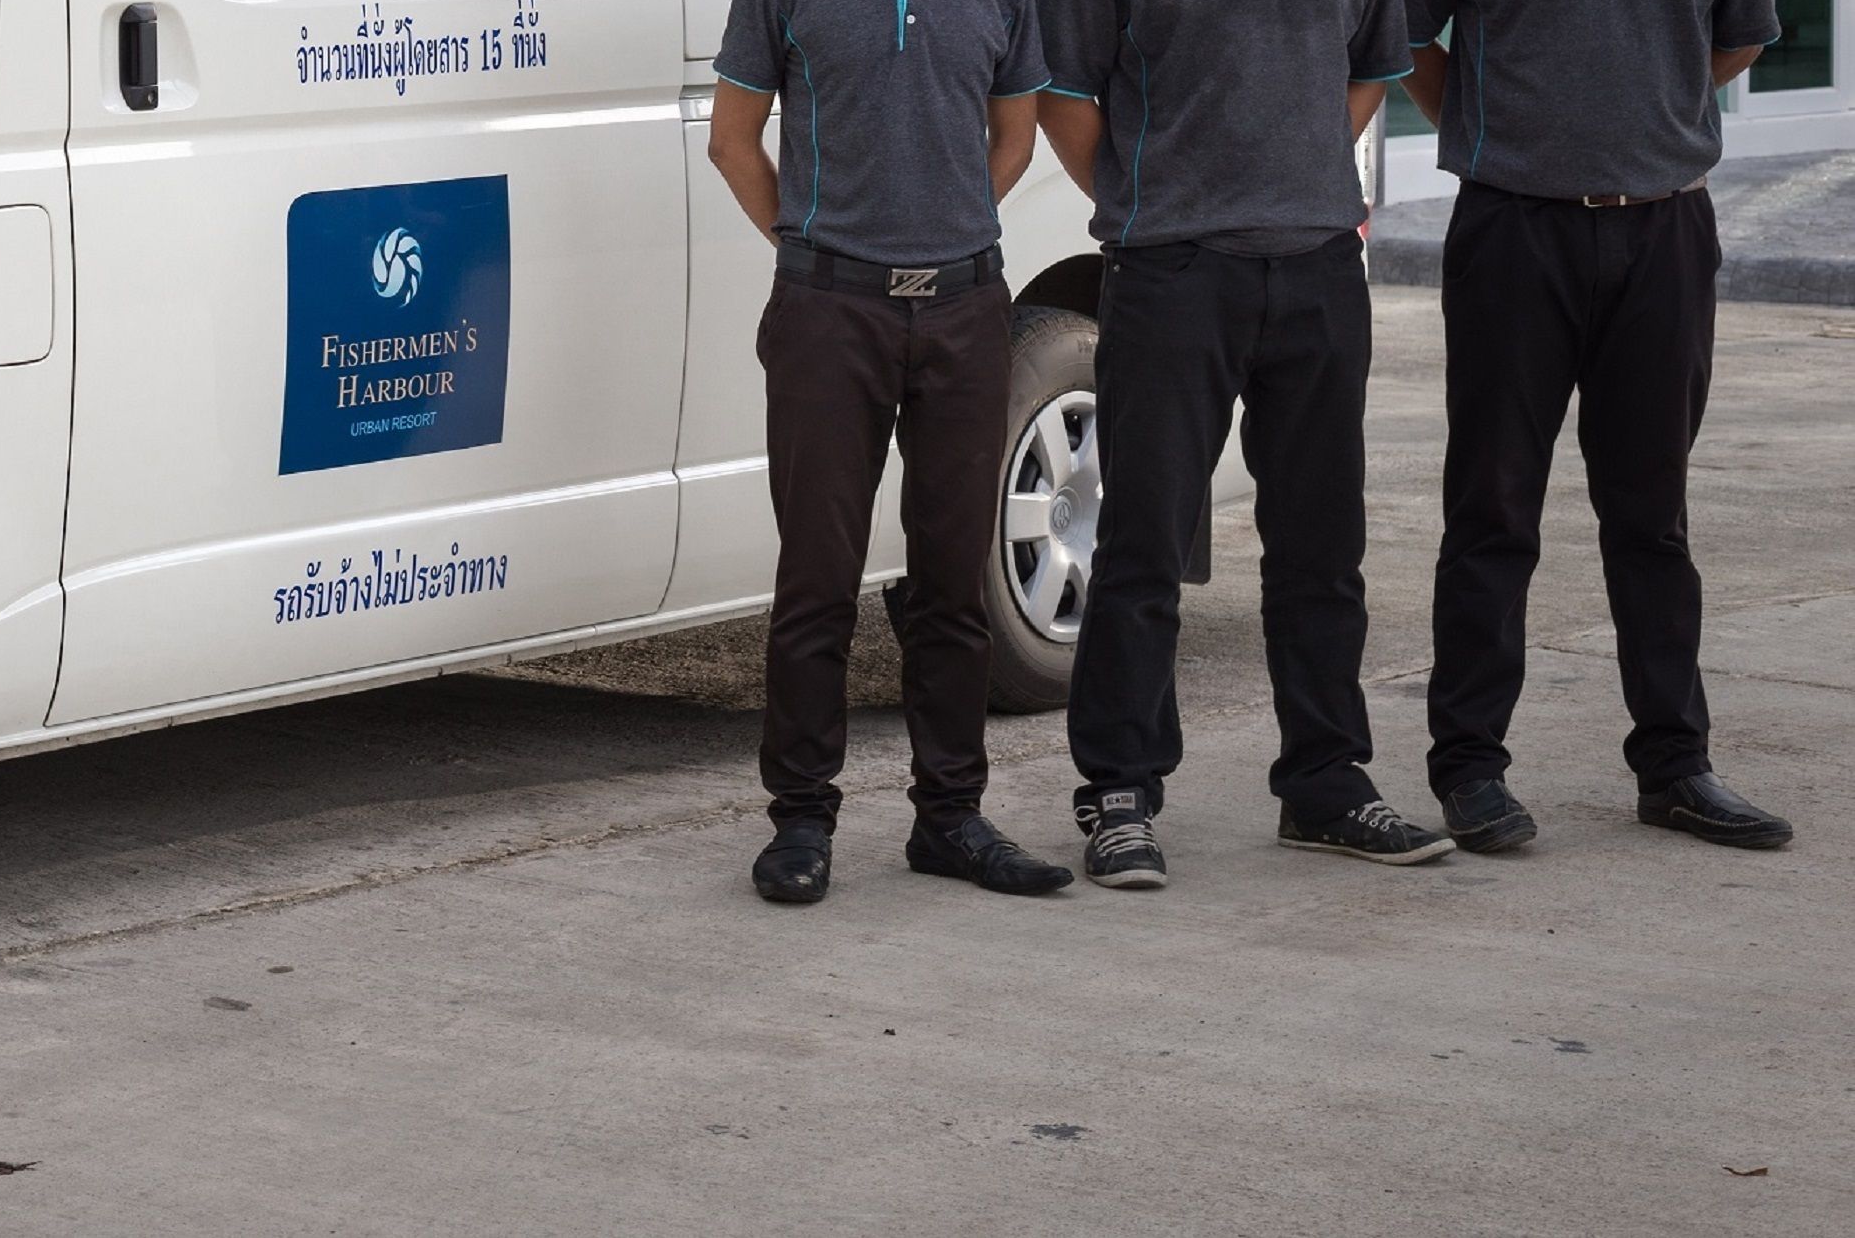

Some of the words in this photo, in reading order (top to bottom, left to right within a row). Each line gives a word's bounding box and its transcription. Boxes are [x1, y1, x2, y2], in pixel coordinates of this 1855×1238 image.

[296, 2, 470, 96] จำนวนที่นั่งผู้โดยสาร
[480, 27, 502, 71] 15
[320, 318, 477, 369] FISHERMEN'S
[336, 371, 455, 409] HARBOUR
[350, 418, 389, 437] URBAN
[391, 411, 438, 431] RESORT
[273, 541, 508, 625] รถรับจ้างไม่ประจำทาง
